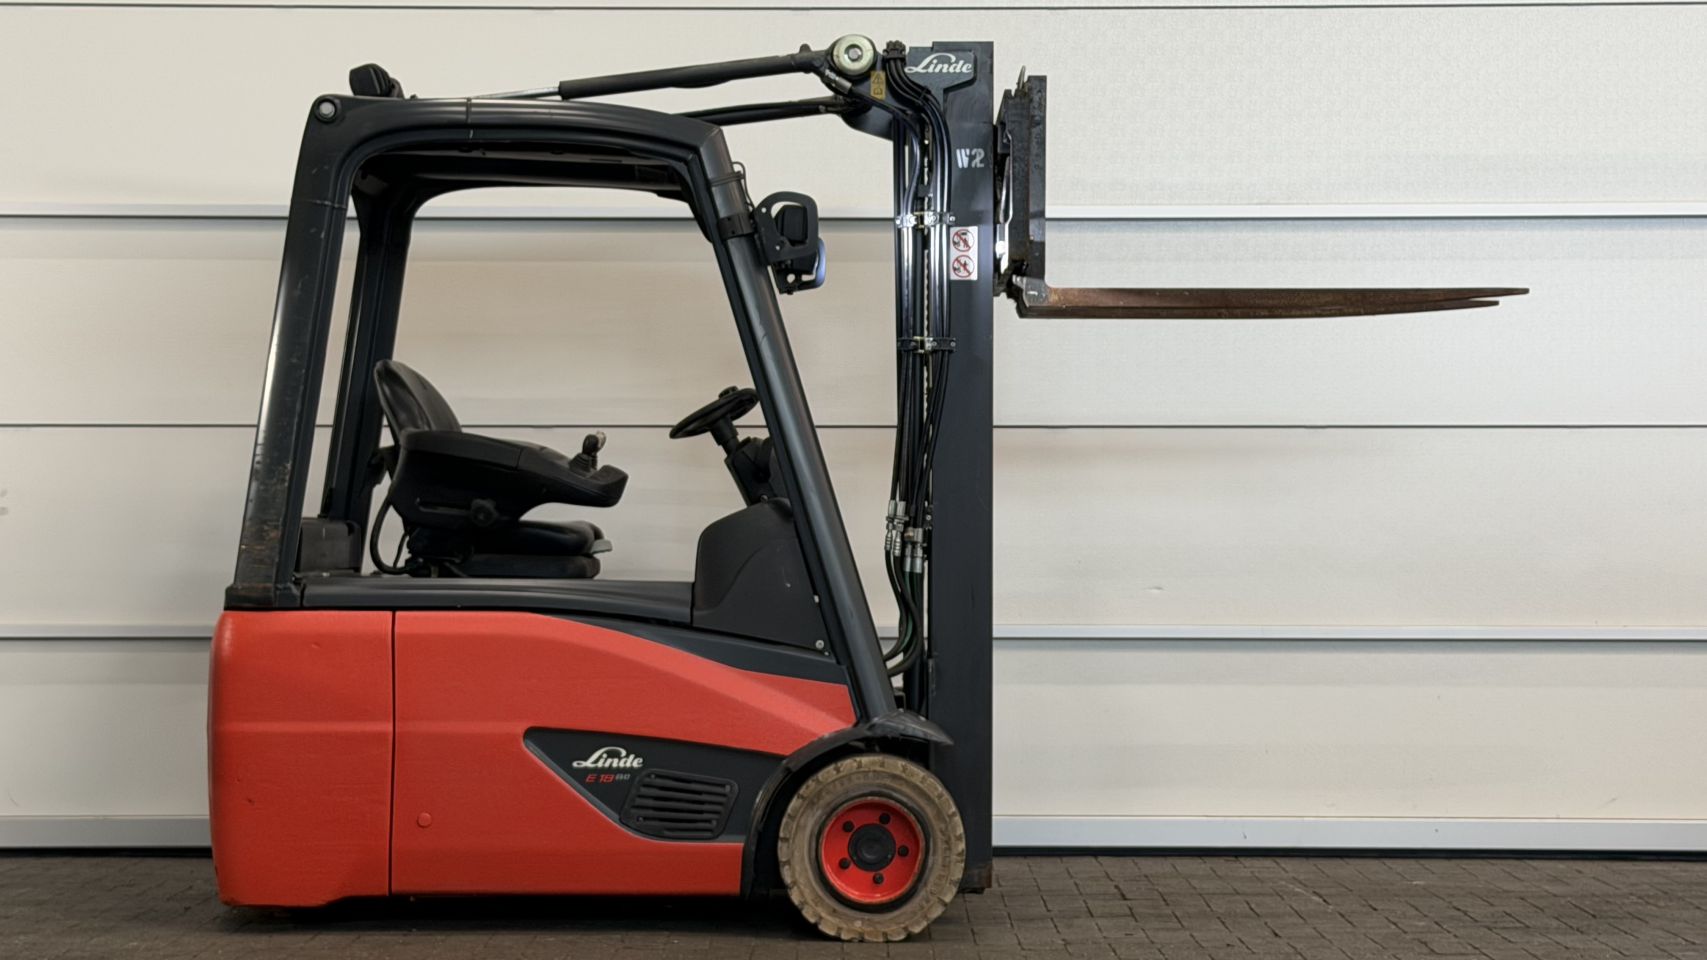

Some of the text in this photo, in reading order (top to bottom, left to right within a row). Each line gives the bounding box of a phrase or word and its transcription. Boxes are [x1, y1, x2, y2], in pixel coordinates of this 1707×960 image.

[904, 52, 973, 73] Linde
[572, 746, 644, 768] Linde
[585, 774, 597, 783] E
